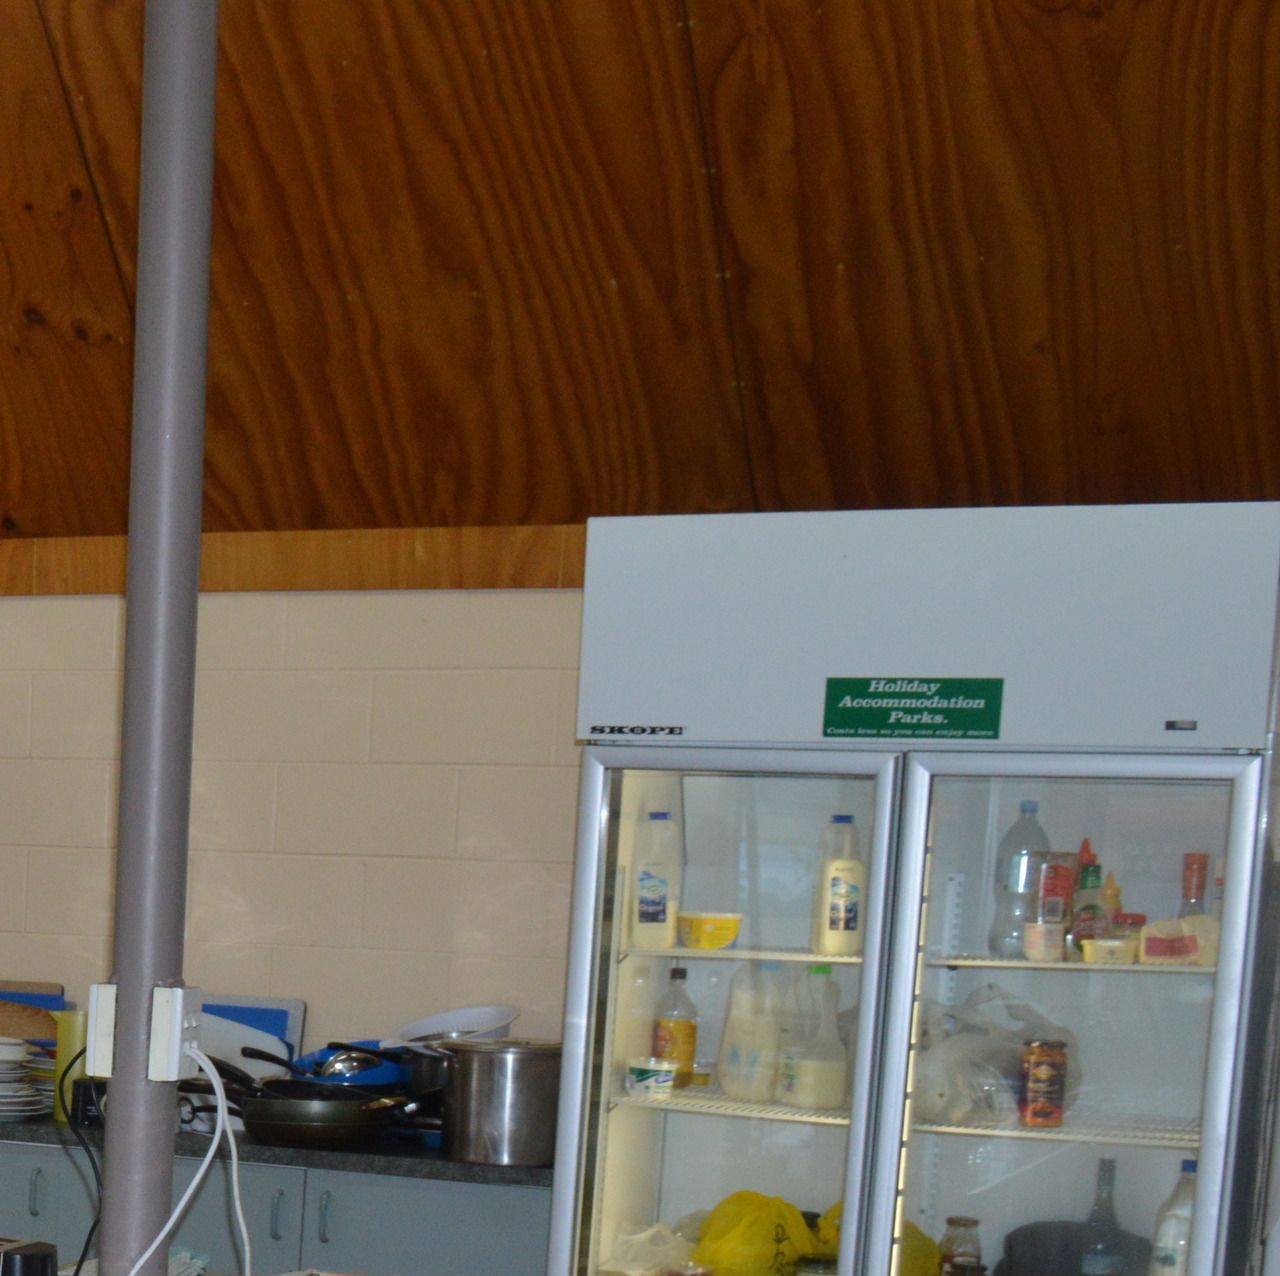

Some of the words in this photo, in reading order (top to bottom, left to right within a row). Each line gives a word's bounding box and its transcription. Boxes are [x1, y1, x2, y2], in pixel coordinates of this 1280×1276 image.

[868, 680, 941, 695] Holiday
[838, 695, 985, 709] Accommodation
[887, 711, 948, 724] Parks.
[589, 725, 684, 735] SKOPE
